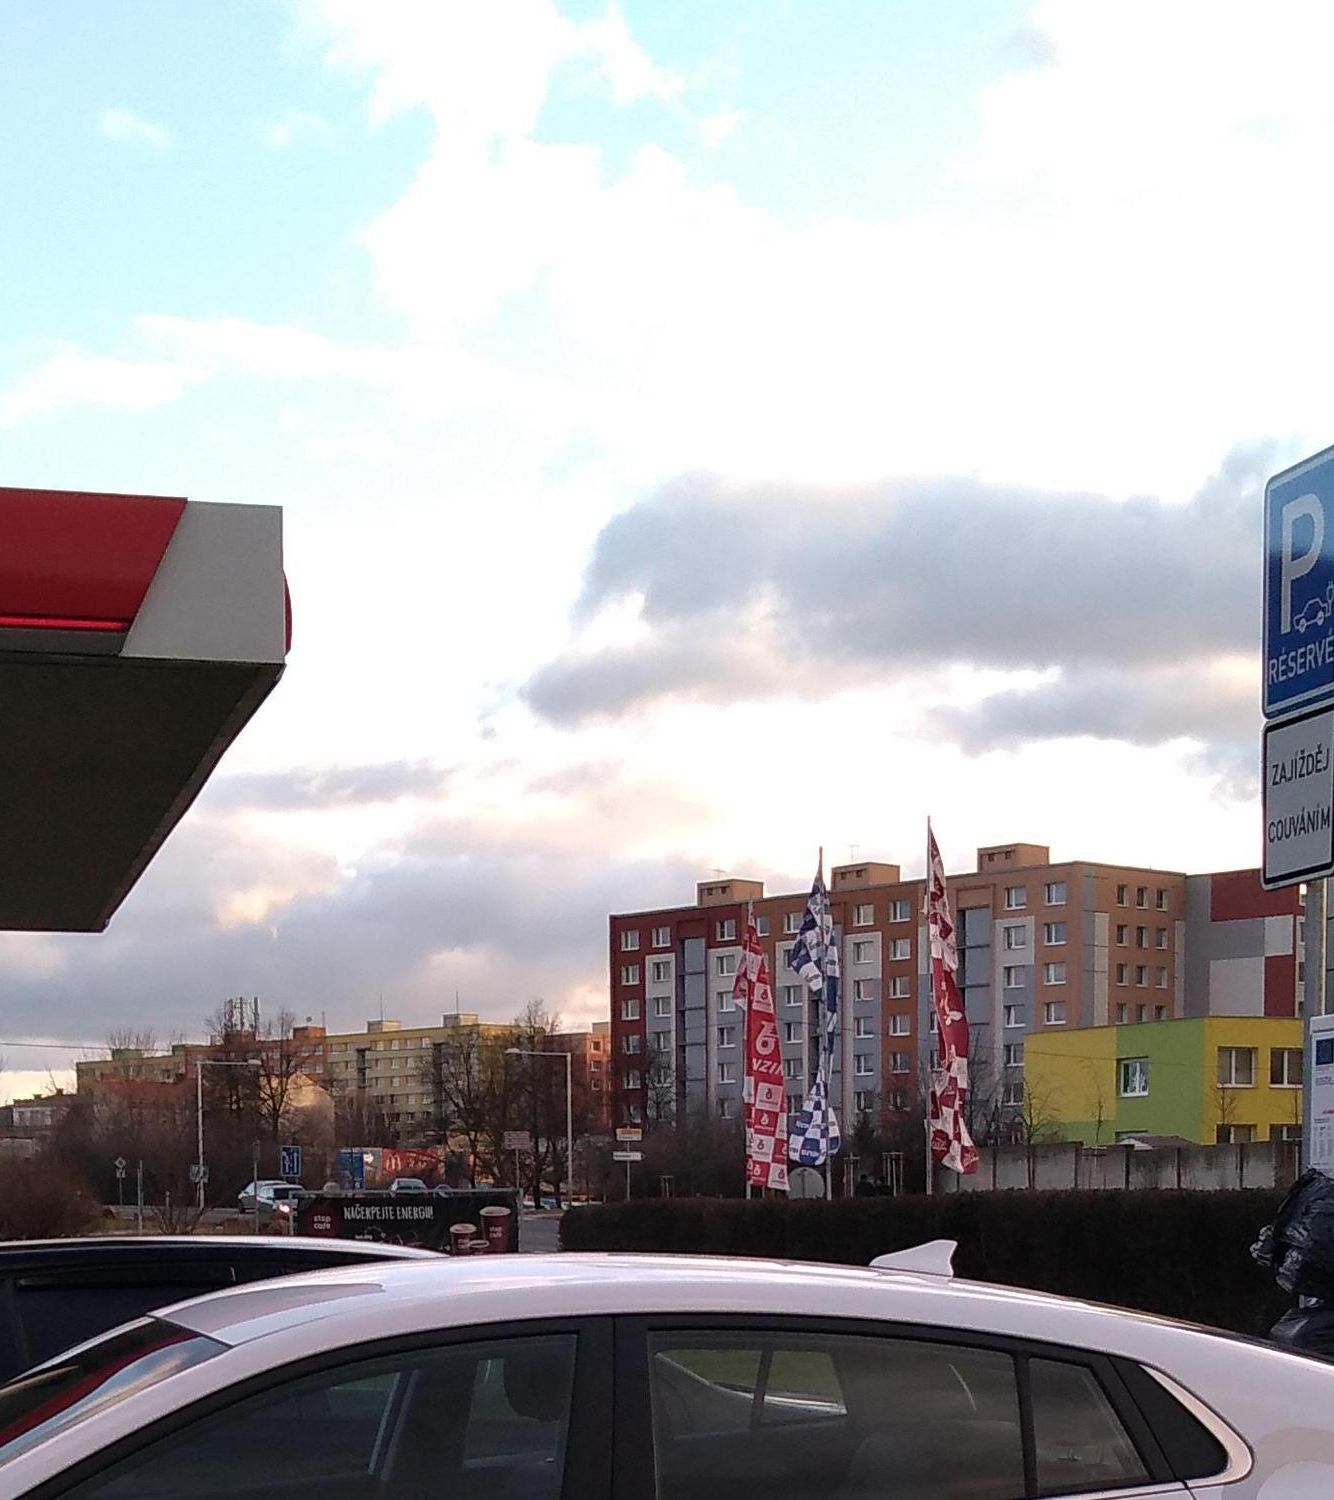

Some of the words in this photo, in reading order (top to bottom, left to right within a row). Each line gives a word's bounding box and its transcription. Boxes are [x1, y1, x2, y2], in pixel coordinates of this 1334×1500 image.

[1268, 634, 1334, 685] RÉSERVÉ
[1272, 743, 1330, 787] ZAJÍŽDĚJ
[1268, 804, 1331, 843] COUVÁNÍM
[343, 1203, 395, 1220] NAČERPEJTE
